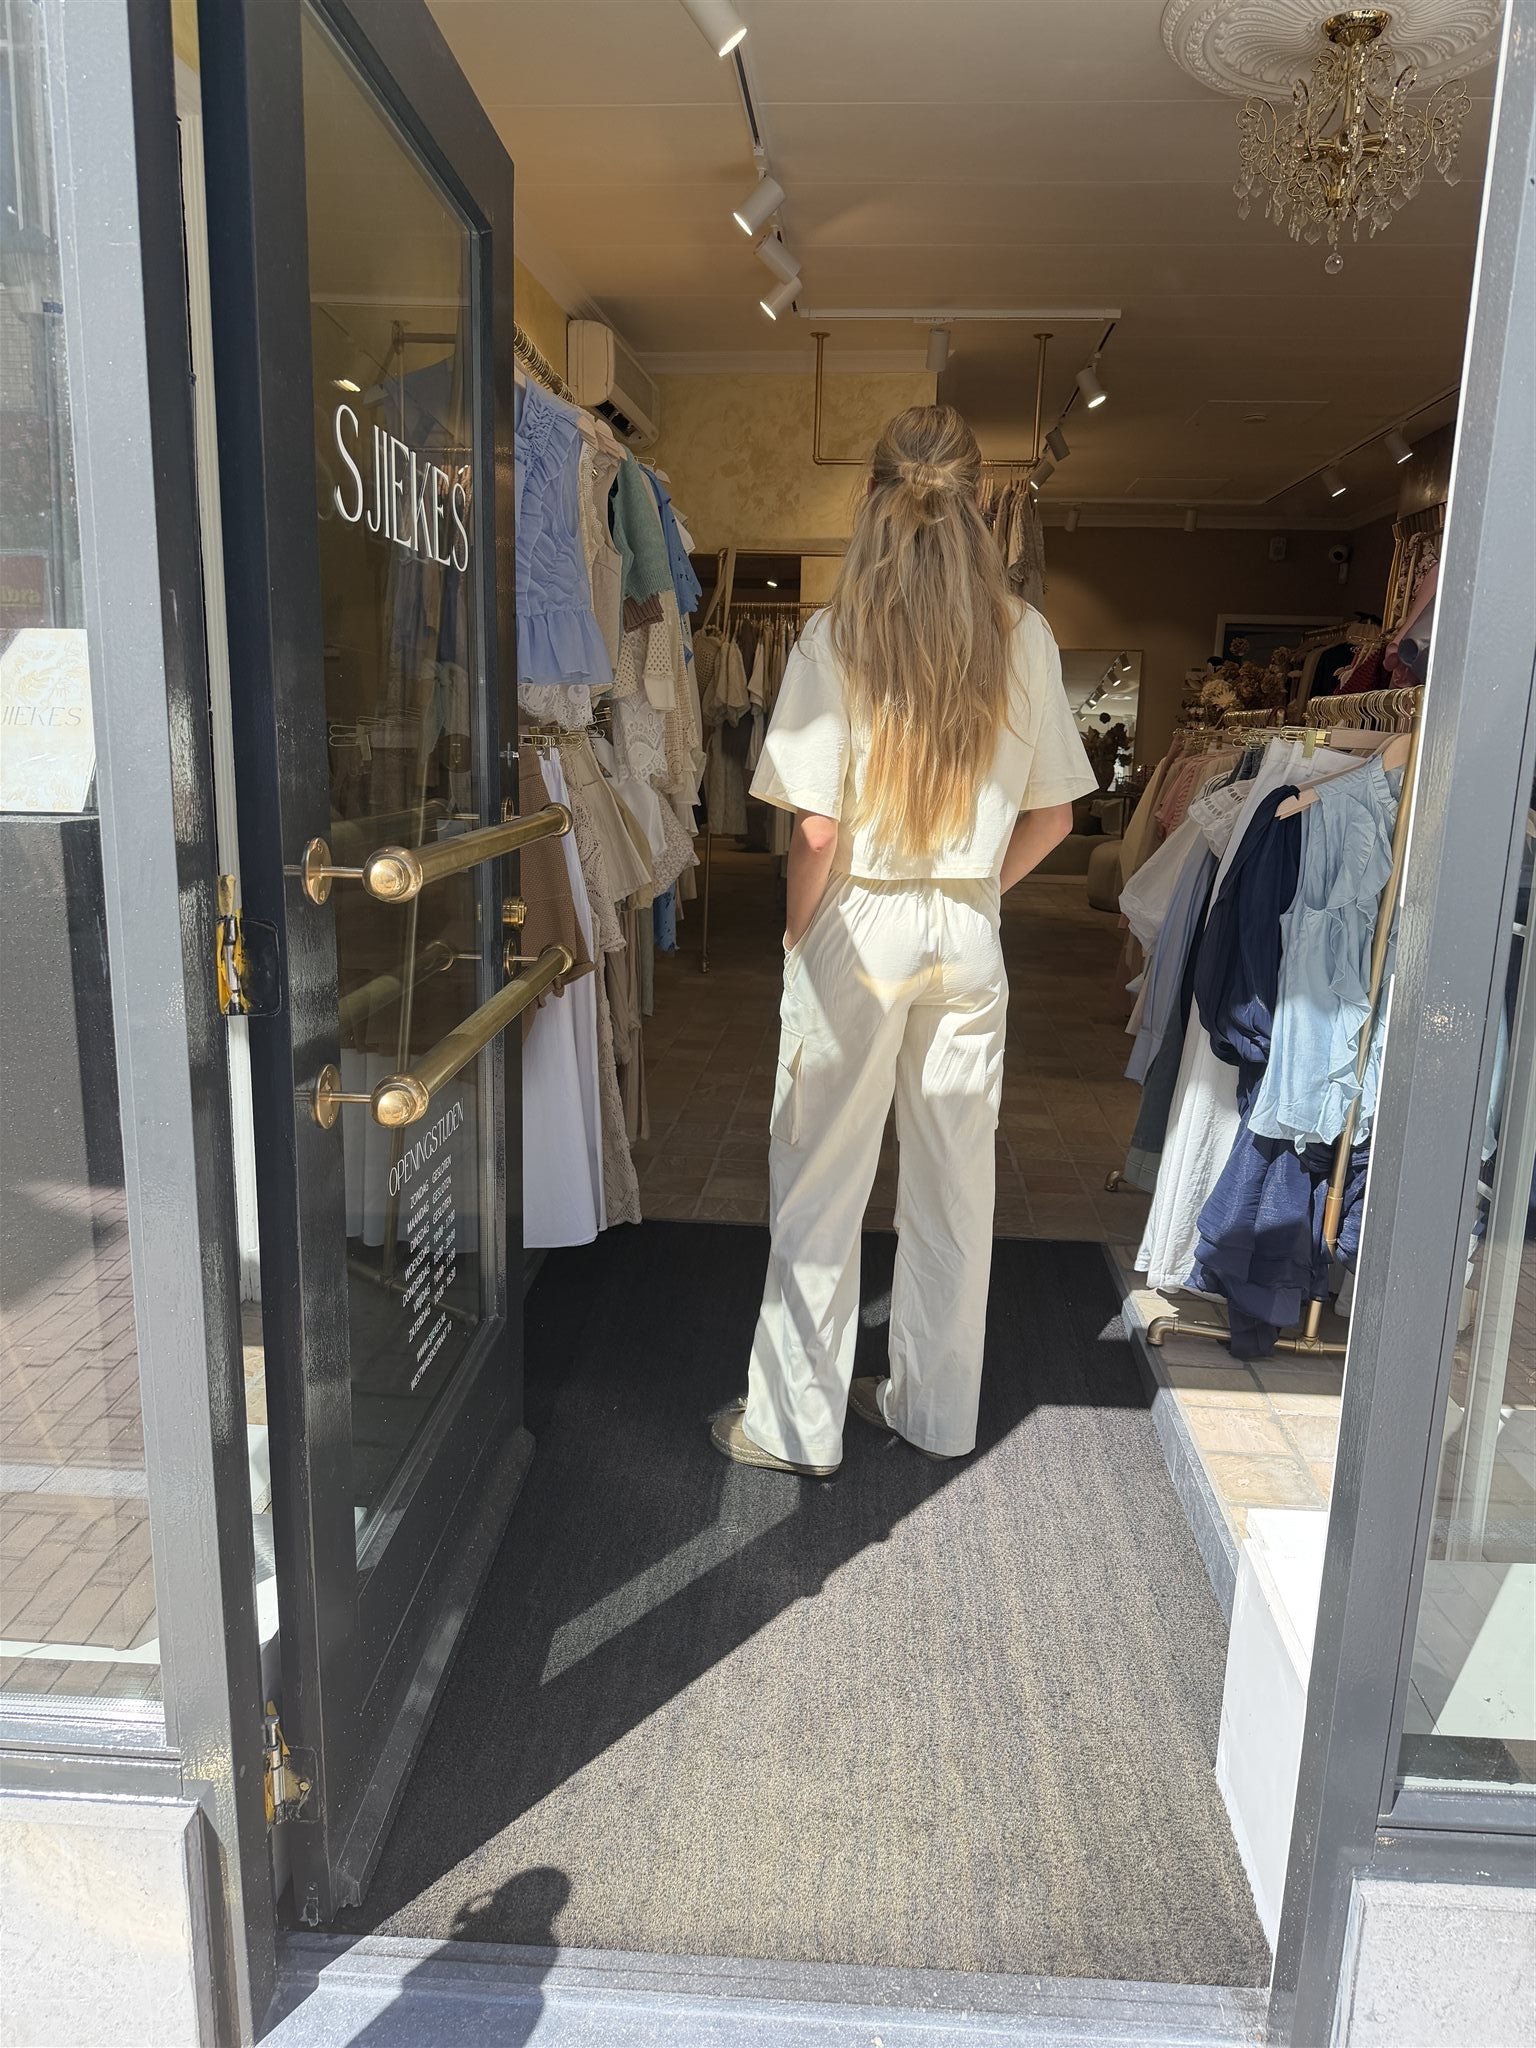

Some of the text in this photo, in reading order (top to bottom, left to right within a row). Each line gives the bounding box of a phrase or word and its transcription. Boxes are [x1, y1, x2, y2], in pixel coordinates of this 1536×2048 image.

[334, 403, 469, 572] SJIEKES
[389, 1097, 464, 1197] OPENINGSTIJDEN
[407, 1174, 452, 1236] MAANDAG GESLOTEN
[410, 1154, 452, 1210] ZONDAG GESLOTEN
[410, 1193, 452, 1254] DINSDAG GESLOTEN
[402, 1262, 430, 1308] DONDERDAG
[405, 1241, 430, 1282] WOENSDAG
[409, 1302, 431, 1344] ZATERDAG
[413, 1282, 431, 1313] VRIJDAG
[416, 1312, 447, 1362] WWW.SJIEKES.NL
